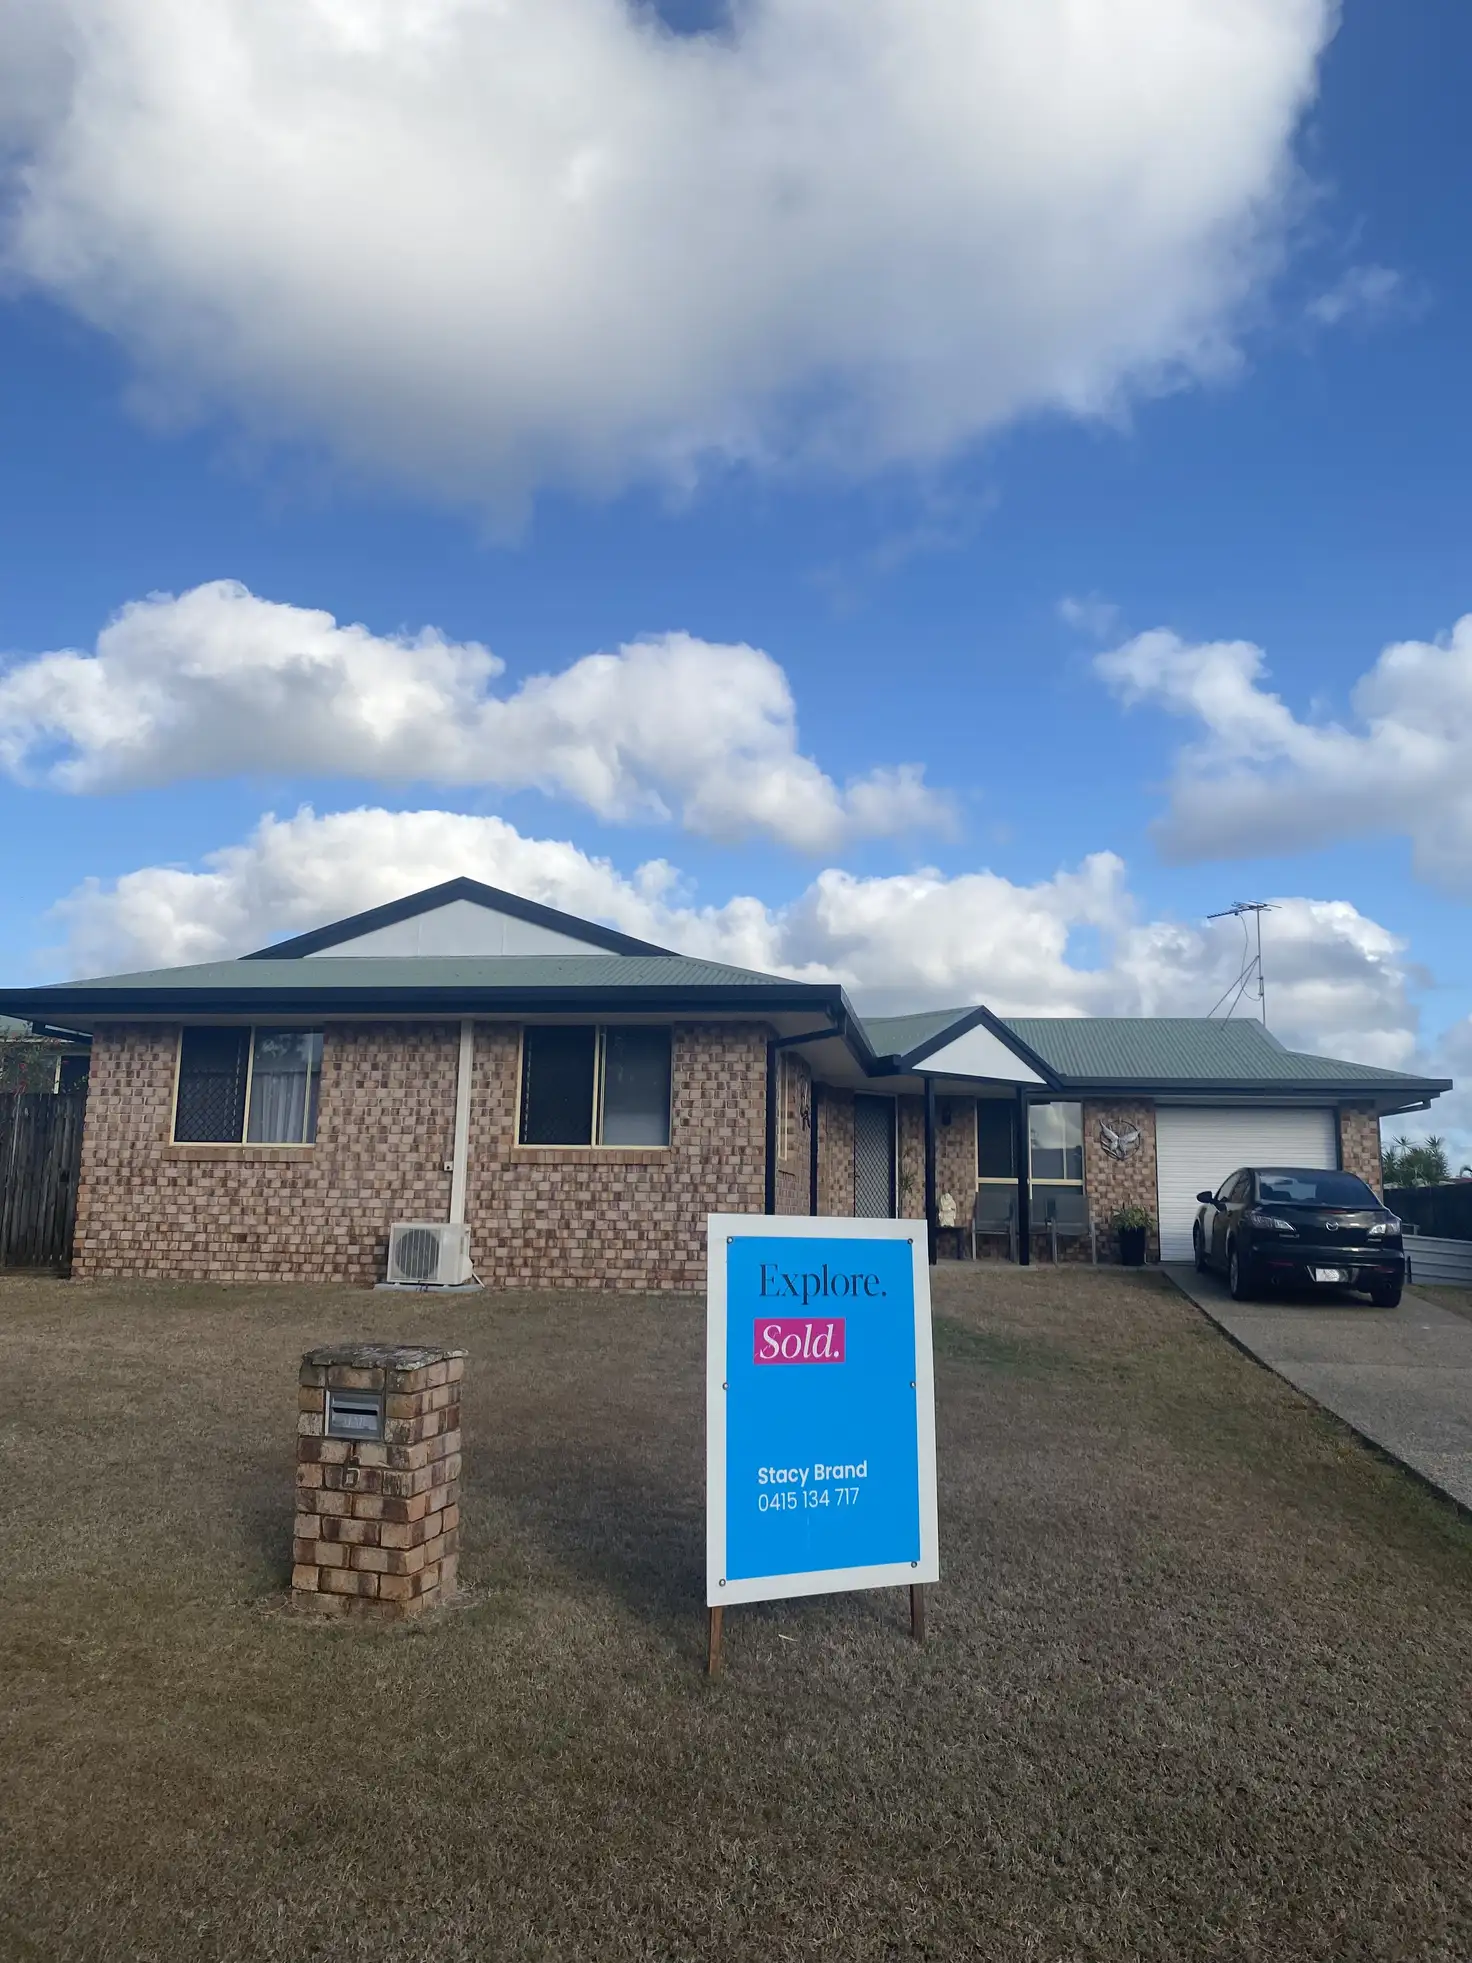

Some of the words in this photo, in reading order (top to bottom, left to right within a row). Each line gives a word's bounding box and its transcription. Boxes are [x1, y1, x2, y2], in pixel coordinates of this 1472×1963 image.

[759, 1263, 887, 1305] Explore.
[760, 1323, 840, 1359] Sold.
[758, 1467, 809, 1488] Stacy
[814, 1460, 867, 1481] Brand
[758, 1492, 798, 1512] 0415
[802, 1489, 830, 1508] 134
[834, 1487, 859, 1506] 717
